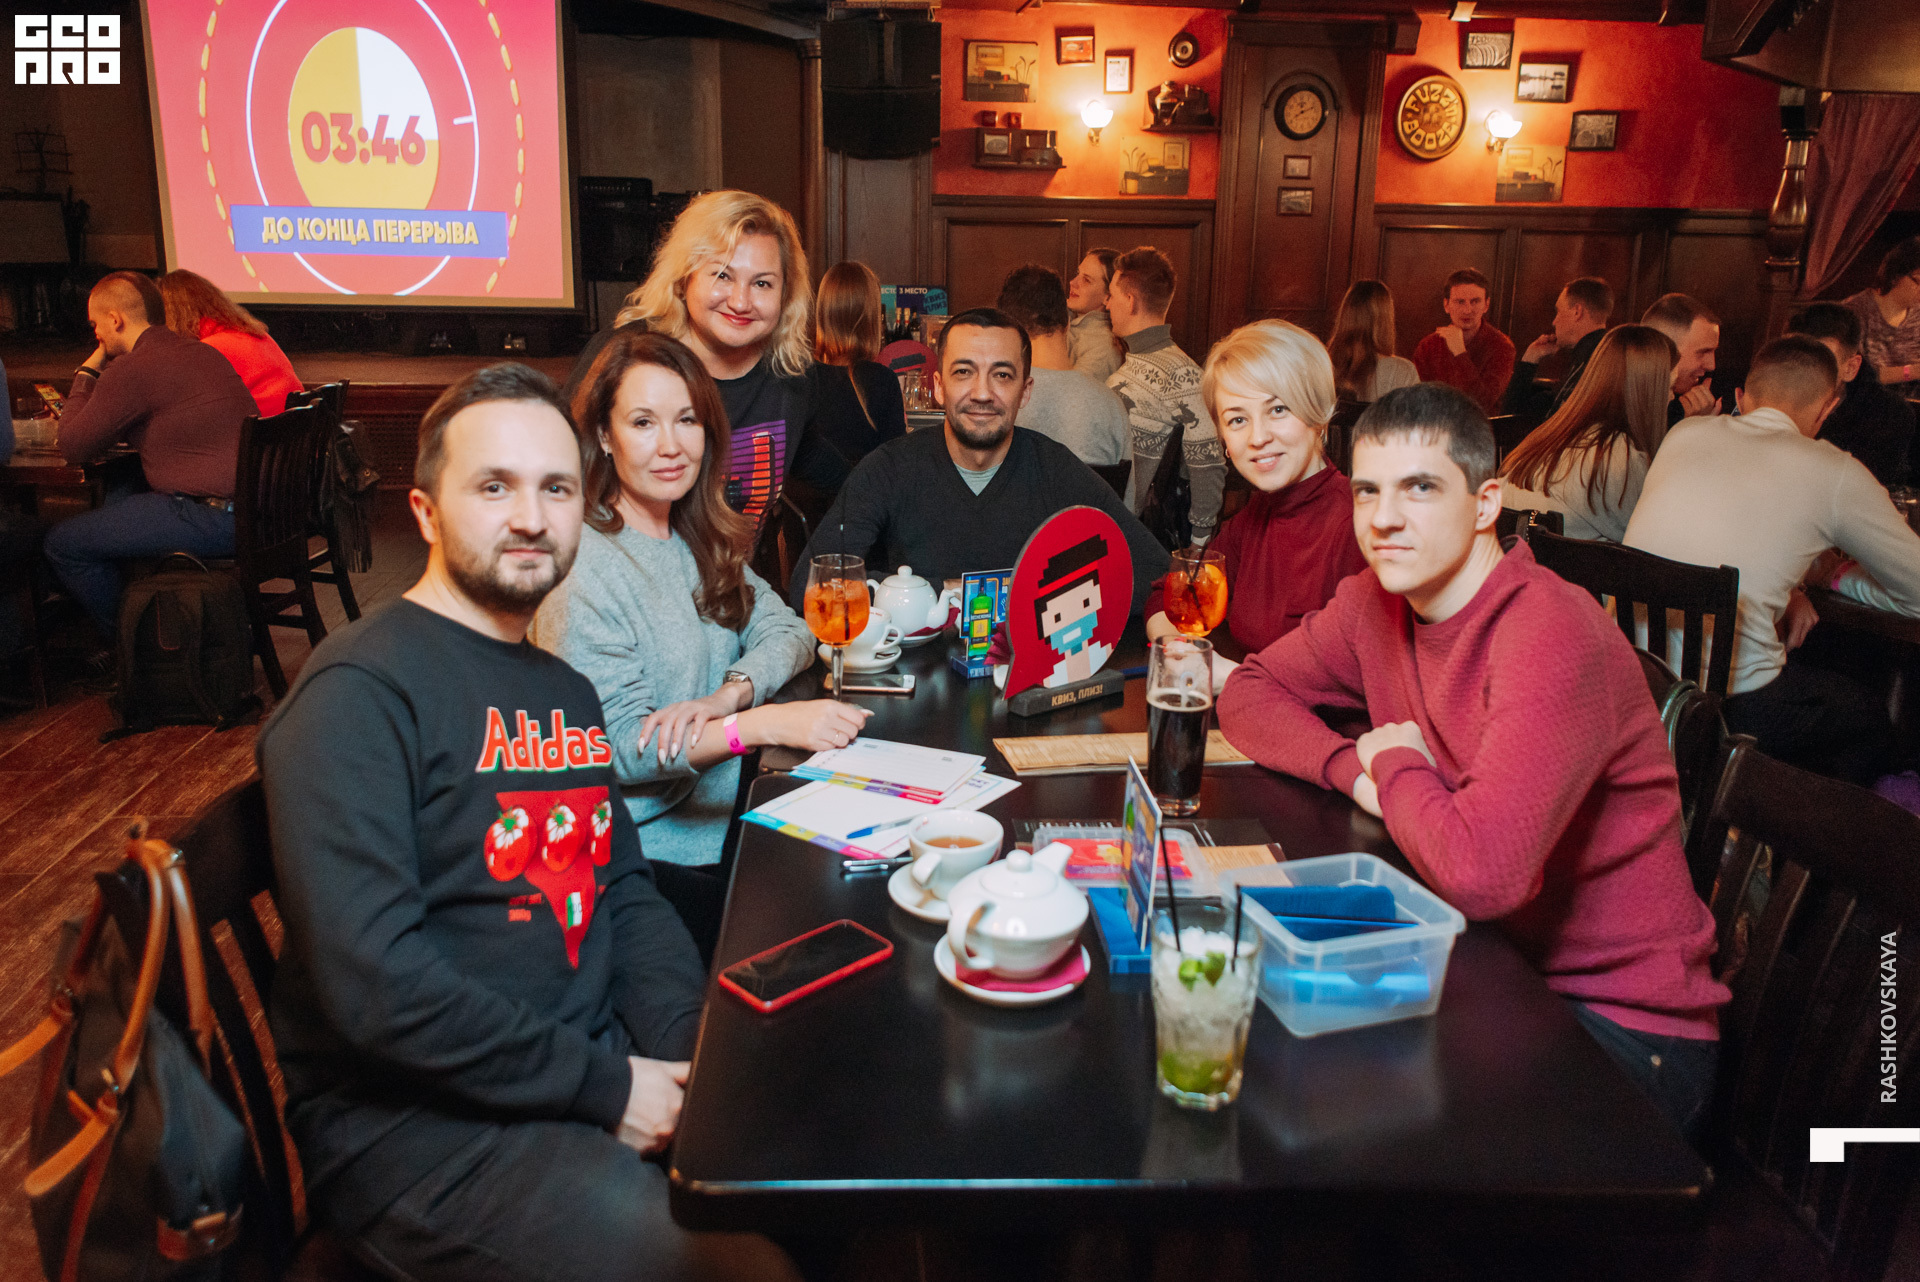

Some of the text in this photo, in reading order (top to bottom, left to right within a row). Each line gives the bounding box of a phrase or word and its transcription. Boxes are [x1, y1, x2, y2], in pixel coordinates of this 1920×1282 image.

[301, 111, 427, 166] 03:46
[1402, 119, 1459, 151] BOOZE
[261, 216, 480, 246] ДО КОНЦА ПЕРЕРЫВА
[1051, 683, 1104, 707] КВИЗ, ПЛИЗ!
[475, 706, 613, 773] Adidas
